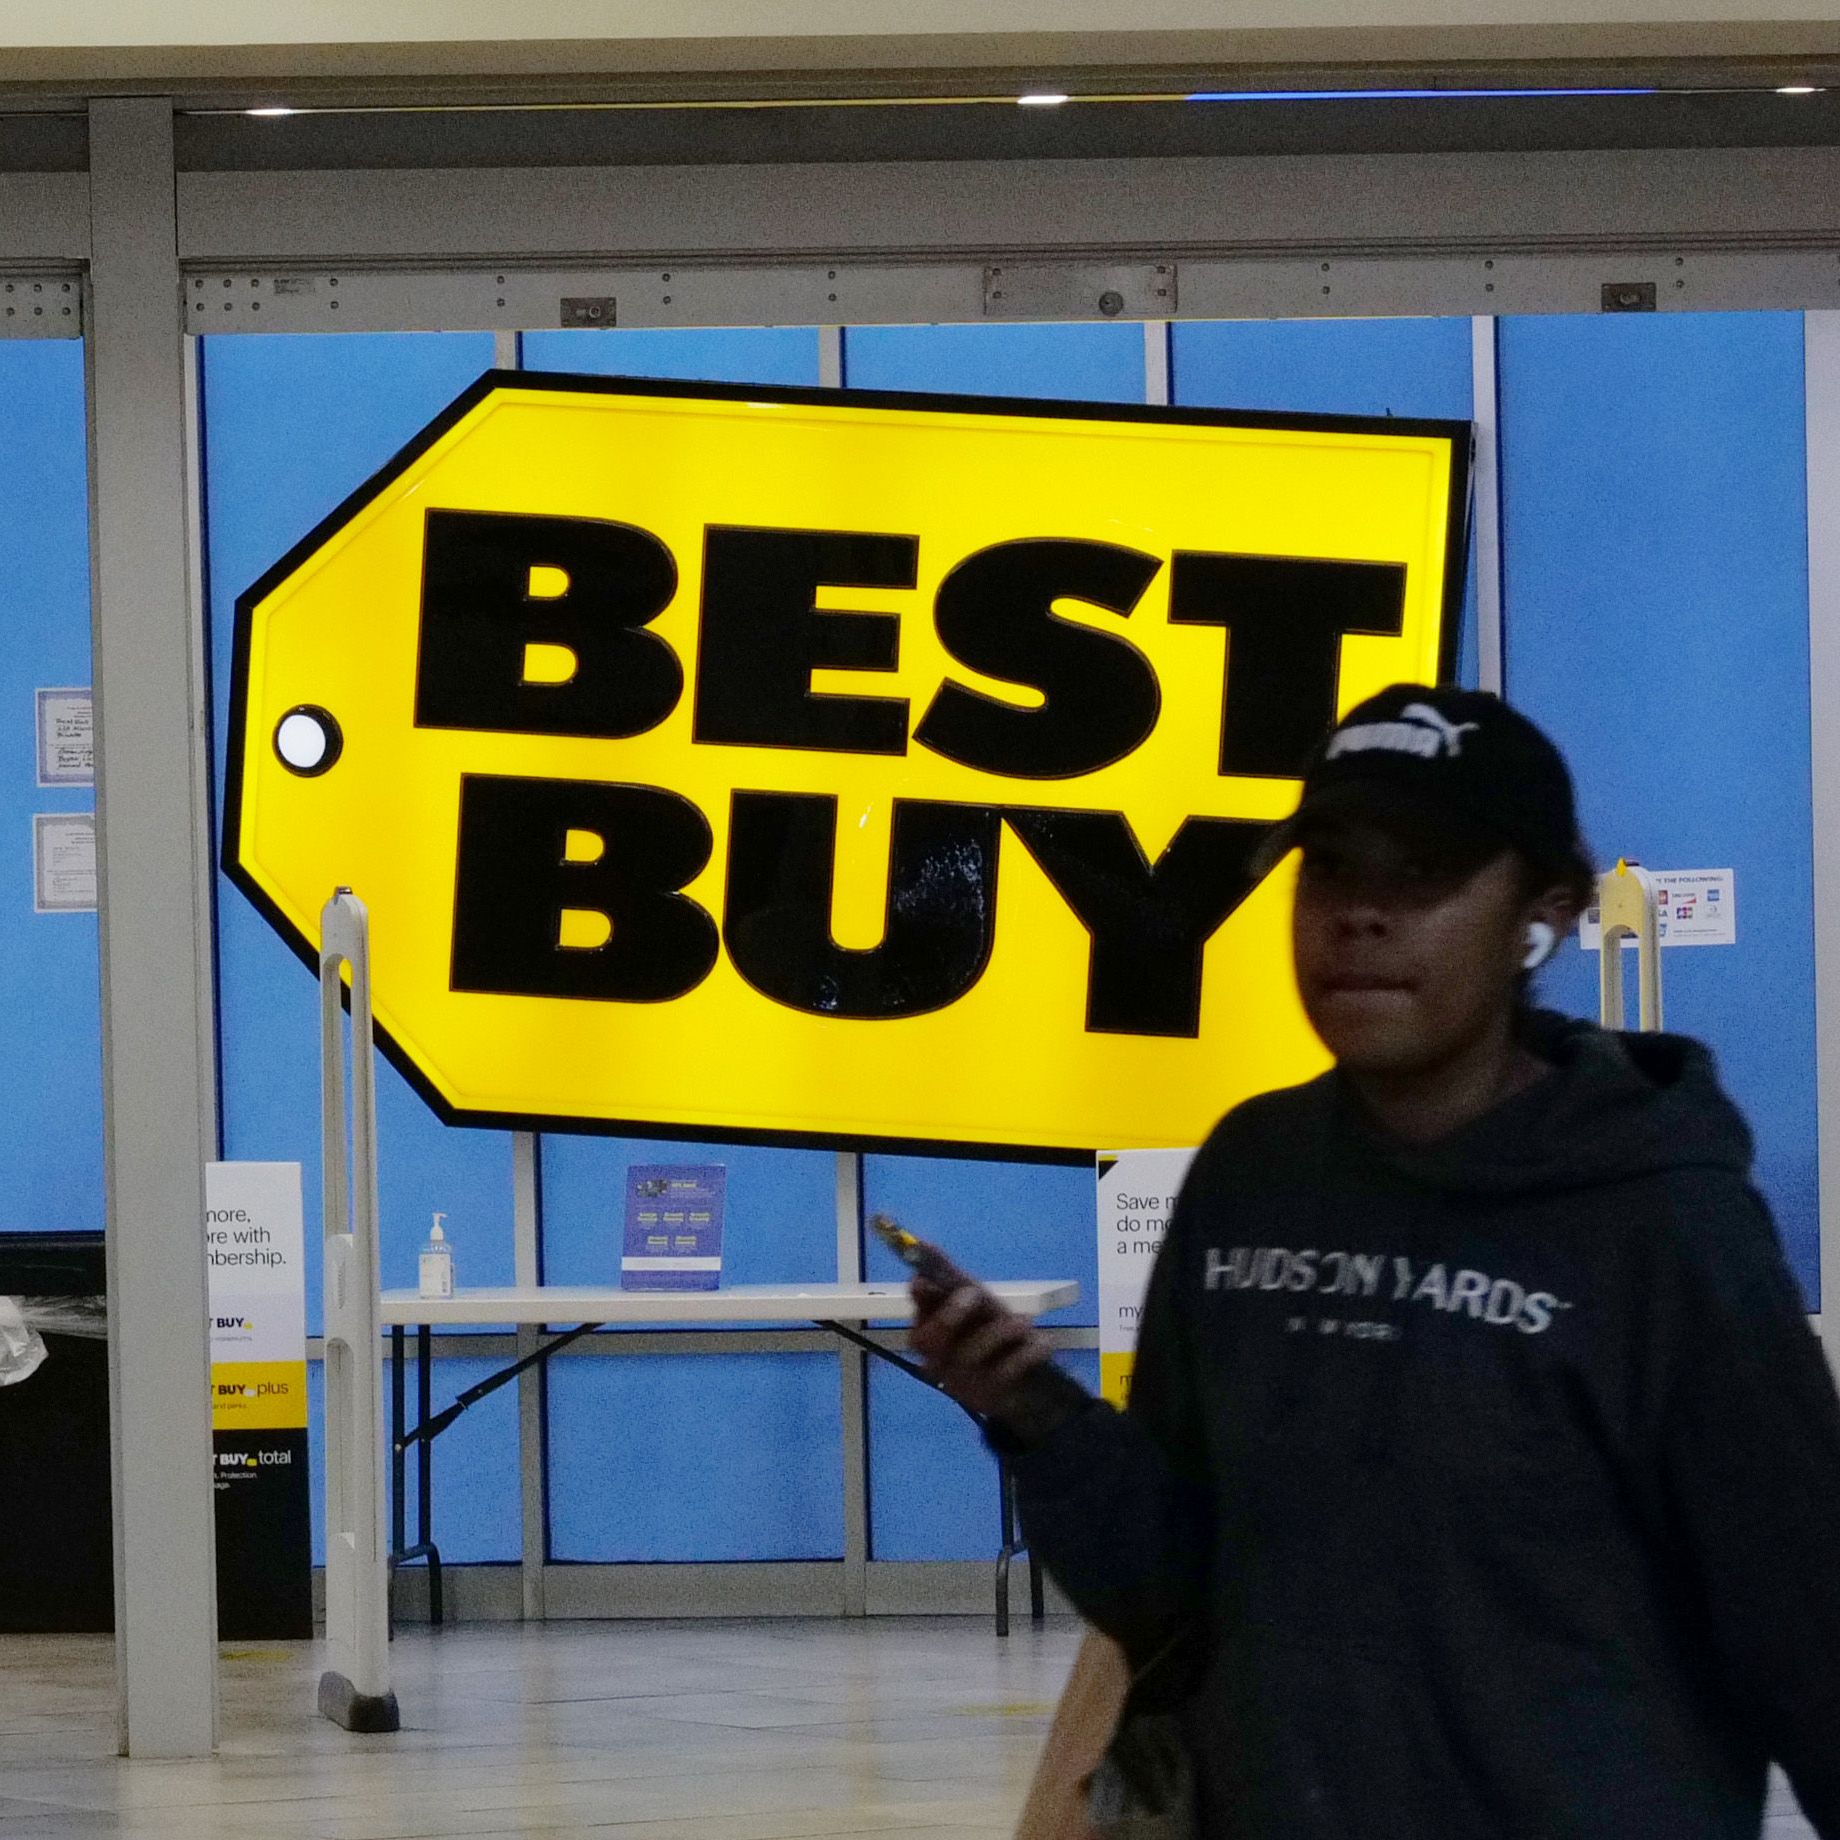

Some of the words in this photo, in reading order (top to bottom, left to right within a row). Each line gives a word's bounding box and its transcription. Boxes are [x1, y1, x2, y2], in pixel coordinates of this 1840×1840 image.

[412, 507, 1408, 781] BEST
[448, 772, 1300, 1038] BUY
[1116, 1192, 1160, 1211] Save
[1116, 1215, 1141, 1233] do
[233, 1226, 271, 1244] with
[1117, 1240, 1127, 1255] a
[1204, 1247, 1386, 1297] HUDSON
[1392, 1256, 1560, 1335] YARDS
[217, 1317, 245, 1329] BUY
[218, 1384, 247, 1396] BUY
[257, 1380, 289, 1399] plus
[219, 1453, 249, 1466] BUY
[258, 1449, 292, 1465] total
